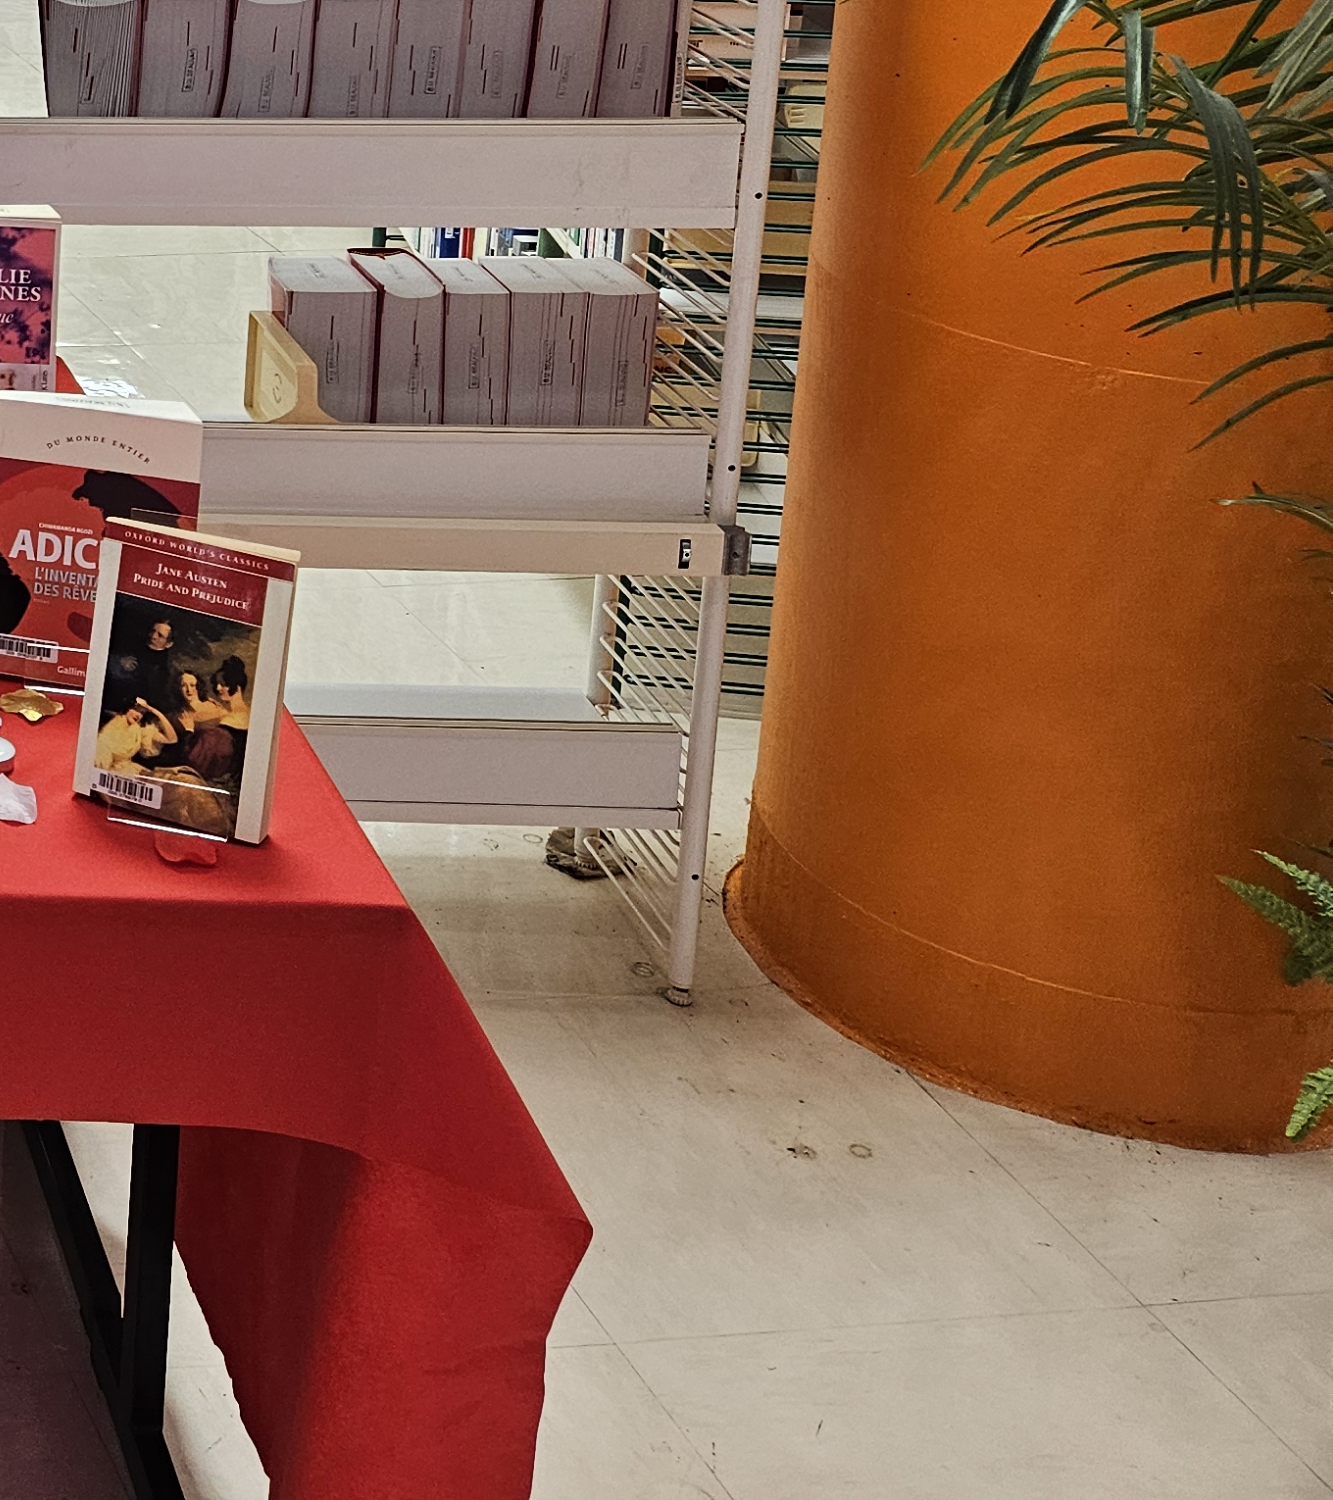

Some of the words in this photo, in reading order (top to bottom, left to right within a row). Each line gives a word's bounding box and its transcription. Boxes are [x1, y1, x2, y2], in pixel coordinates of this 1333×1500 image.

[46, 439, 60, 449] DU
[66, 435, 106, 443] MONDE
[112, 440, 150, 465] ENTIER
[125, 530, 165, 546] OXFORD
[169, 541, 216, 558] WORLD'S
[219, 553, 269, 570] CLASSICS
[34, 582, 59, 597] DES
[155, 563, 183, 578] JANE
[184, 570, 228, 589] AUSTEN
[133, 574, 164, 589] PRIDE
[166, 582, 188, 595] AND
[191, 588, 248, 610] PREJUDICE
